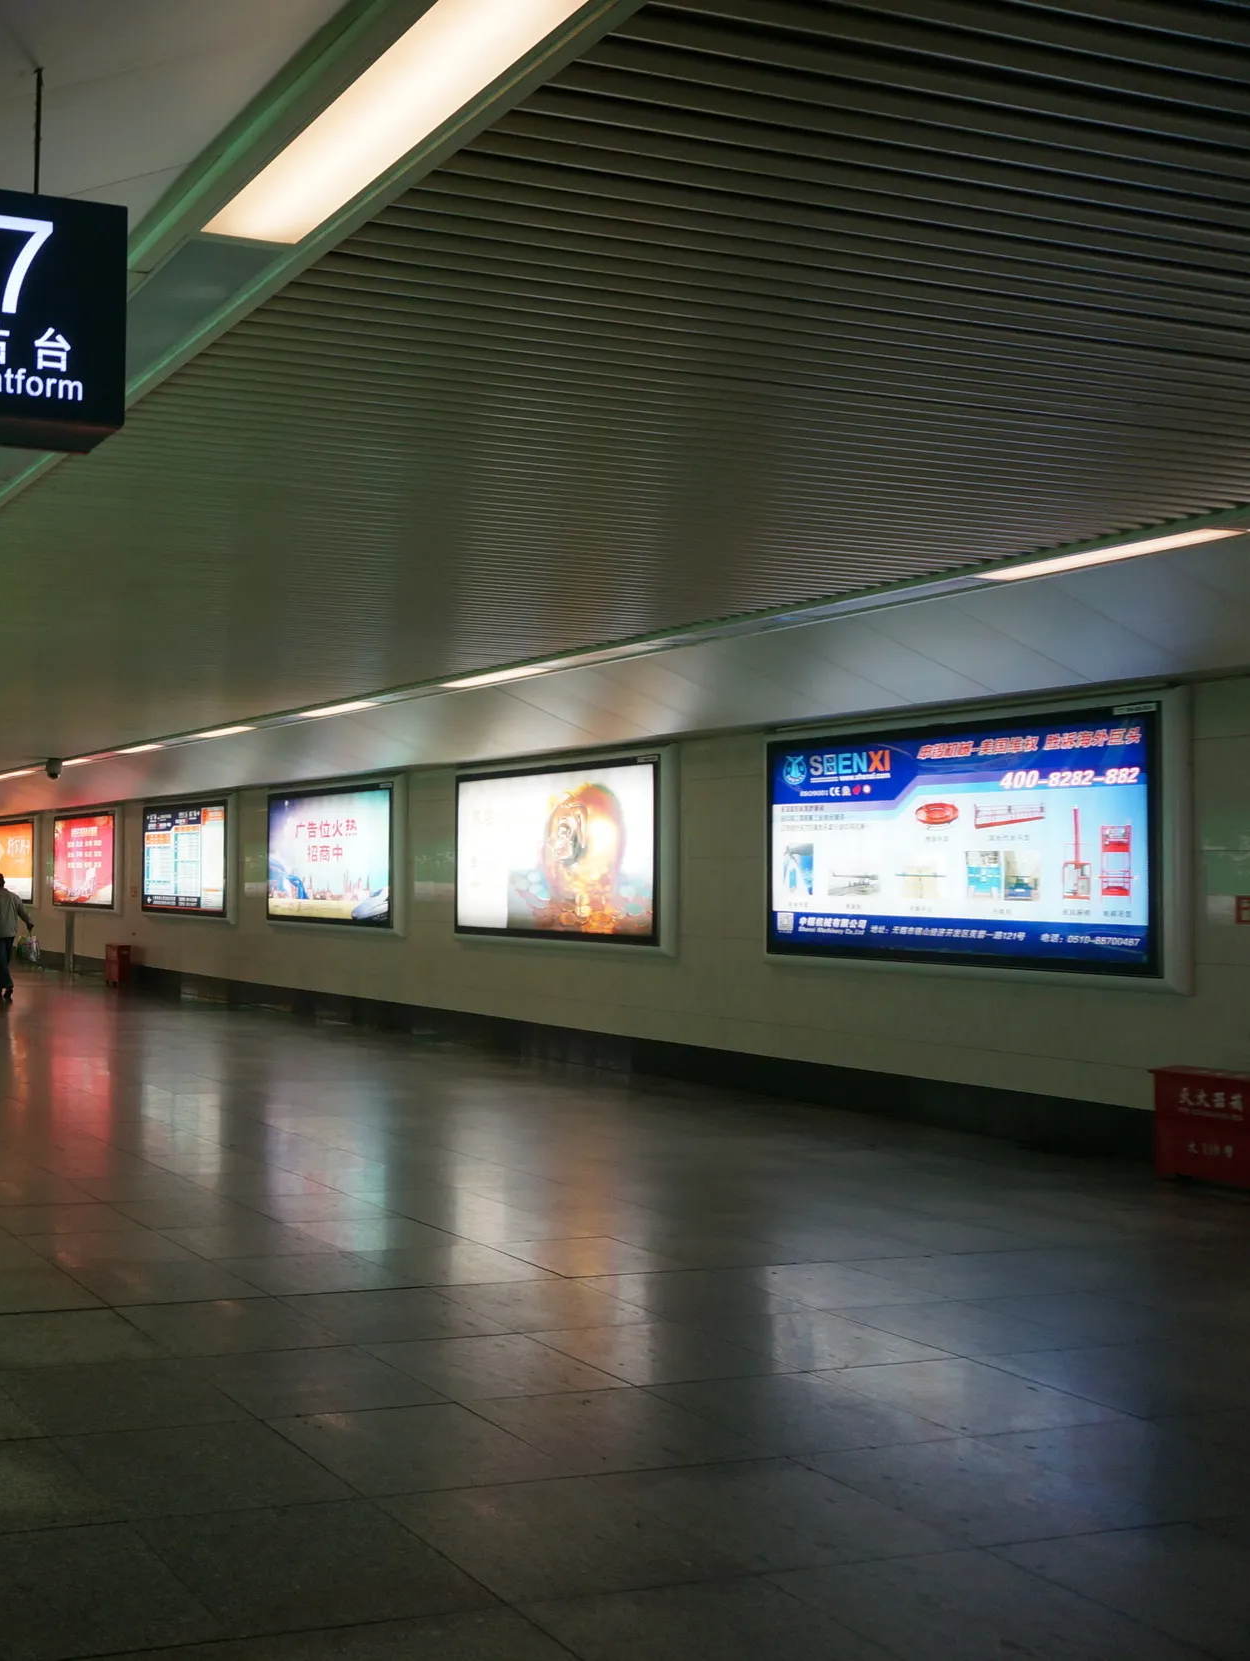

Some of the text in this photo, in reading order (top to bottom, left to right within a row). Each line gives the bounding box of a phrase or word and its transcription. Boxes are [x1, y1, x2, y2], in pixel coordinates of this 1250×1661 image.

[809, 749, 891, 776] SHENXI
[1000, 766, 1141, 790] 400-8282-882
[295, 817, 358, 839] 广告位火热
[307, 844, 344, 862] 招商中
